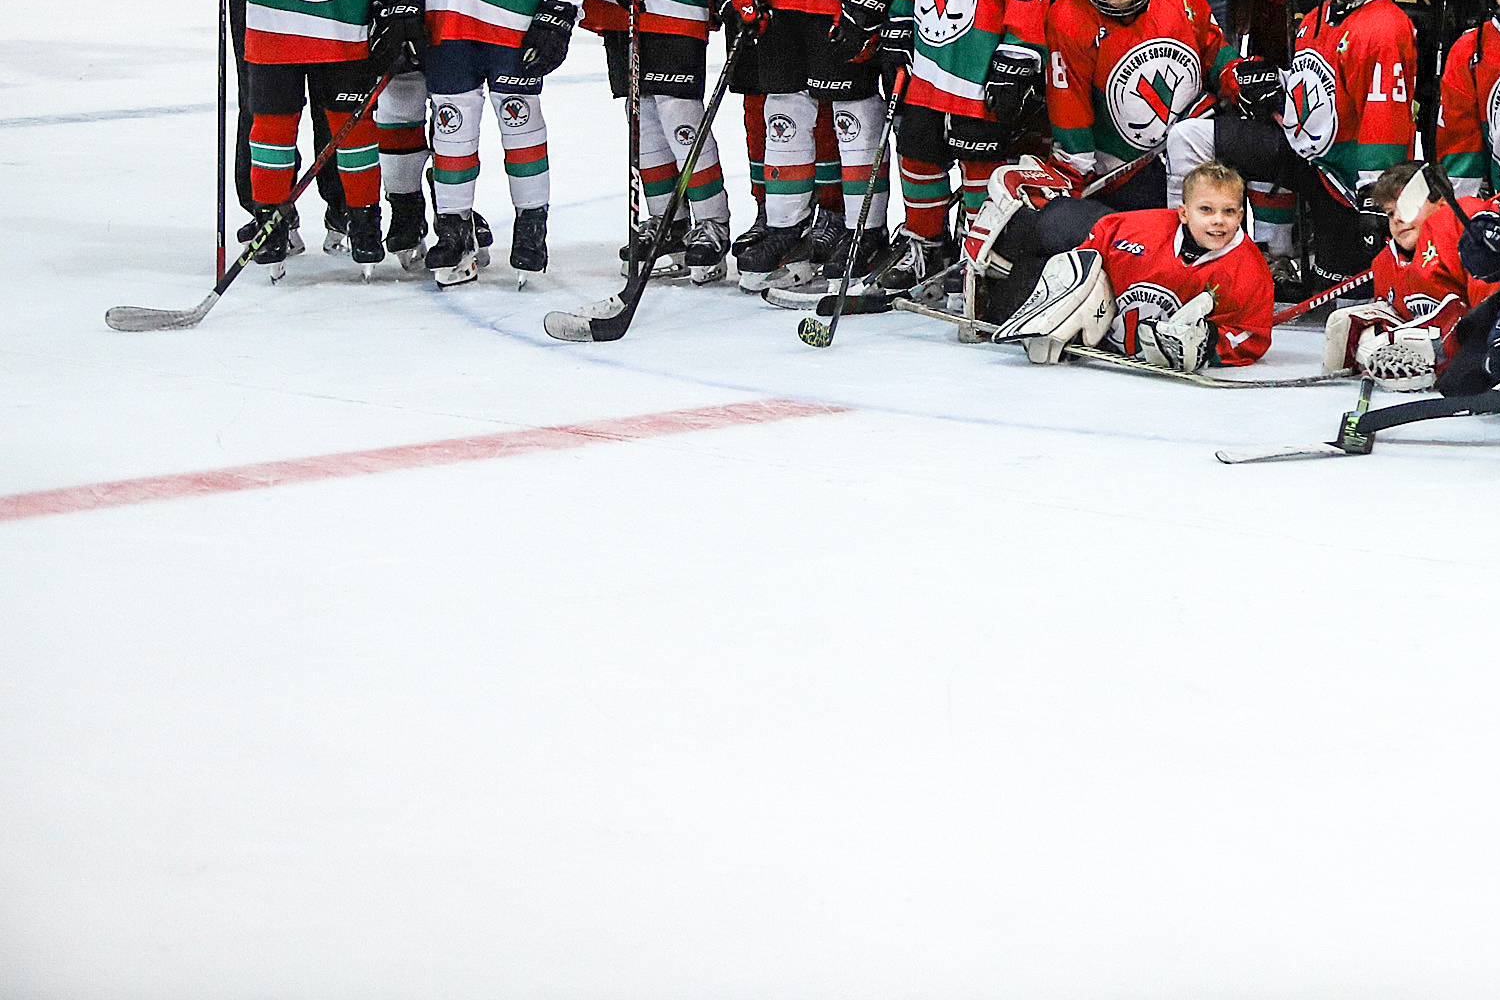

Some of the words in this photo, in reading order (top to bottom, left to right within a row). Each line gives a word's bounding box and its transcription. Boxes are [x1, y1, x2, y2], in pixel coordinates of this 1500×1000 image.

[880, 28, 912, 41] UER
[495, 75, 542, 87] BAUER
[643, 72, 695, 84] BAUER
[806, 77, 852, 90] BAUER
[1366, 61, 1407, 102] 13
[335, 92, 368, 102] BAU
[886, 92, 899, 120] CCM
[948, 136, 999, 152] BAUER
[630, 165, 640, 233] CCM
[1308, 270, 1375, 310] WARRI
